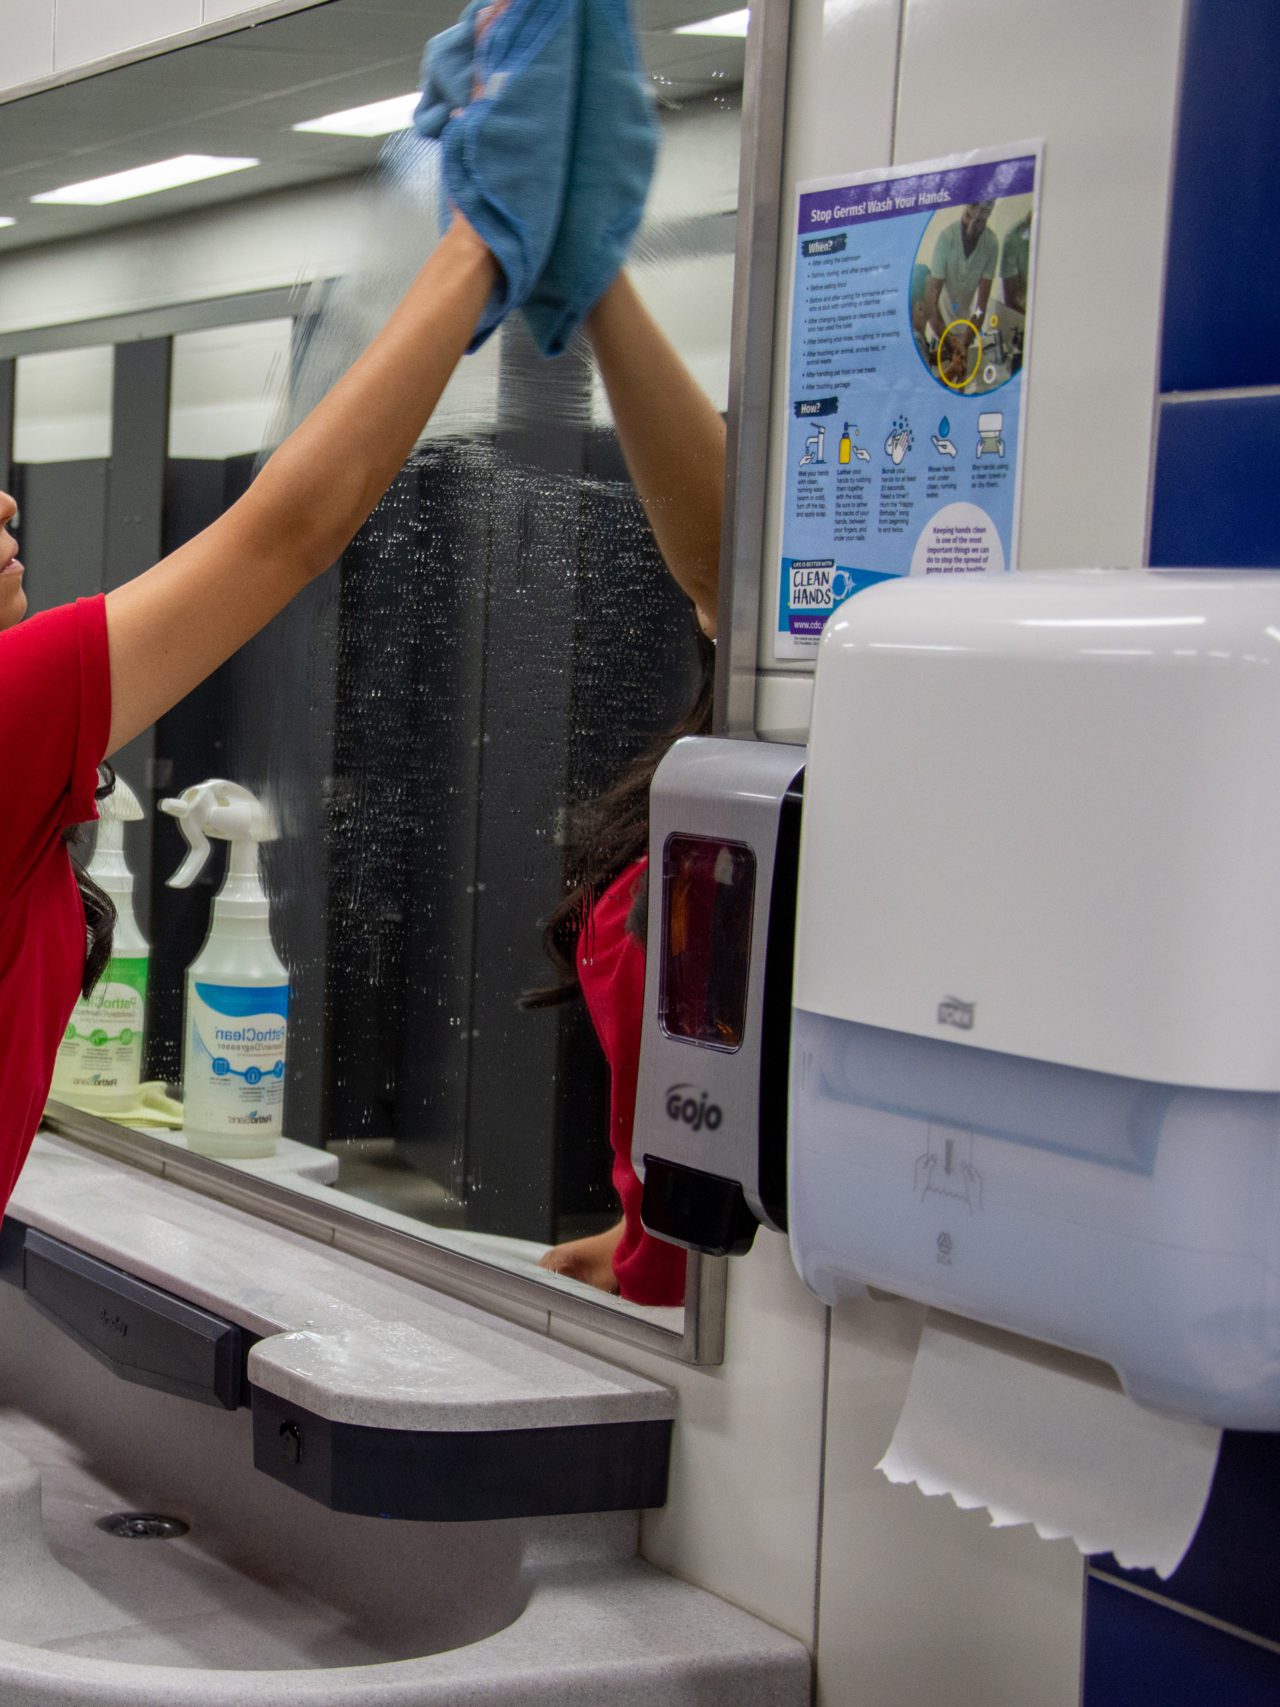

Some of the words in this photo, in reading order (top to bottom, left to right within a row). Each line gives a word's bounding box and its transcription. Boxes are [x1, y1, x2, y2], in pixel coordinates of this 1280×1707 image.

[811, 208, 832, 223] Stop
[834, 202, 866, 219] Germs!
[868, 197, 893, 214] Wash
[895, 194, 916, 209] Your
[918, 188, 951, 205] Hands.
[808, 240, 833, 254] When?
[801, 403, 821, 414] How?
[954, 547, 970, 555] things
[941, 557, 952, 565] stop
[964, 556, 981, 564] spread
[794, 570, 830, 588] CLEAN
[793, 588, 831, 606] HANDS
[794, 620, 824, 629] www.cdc.
